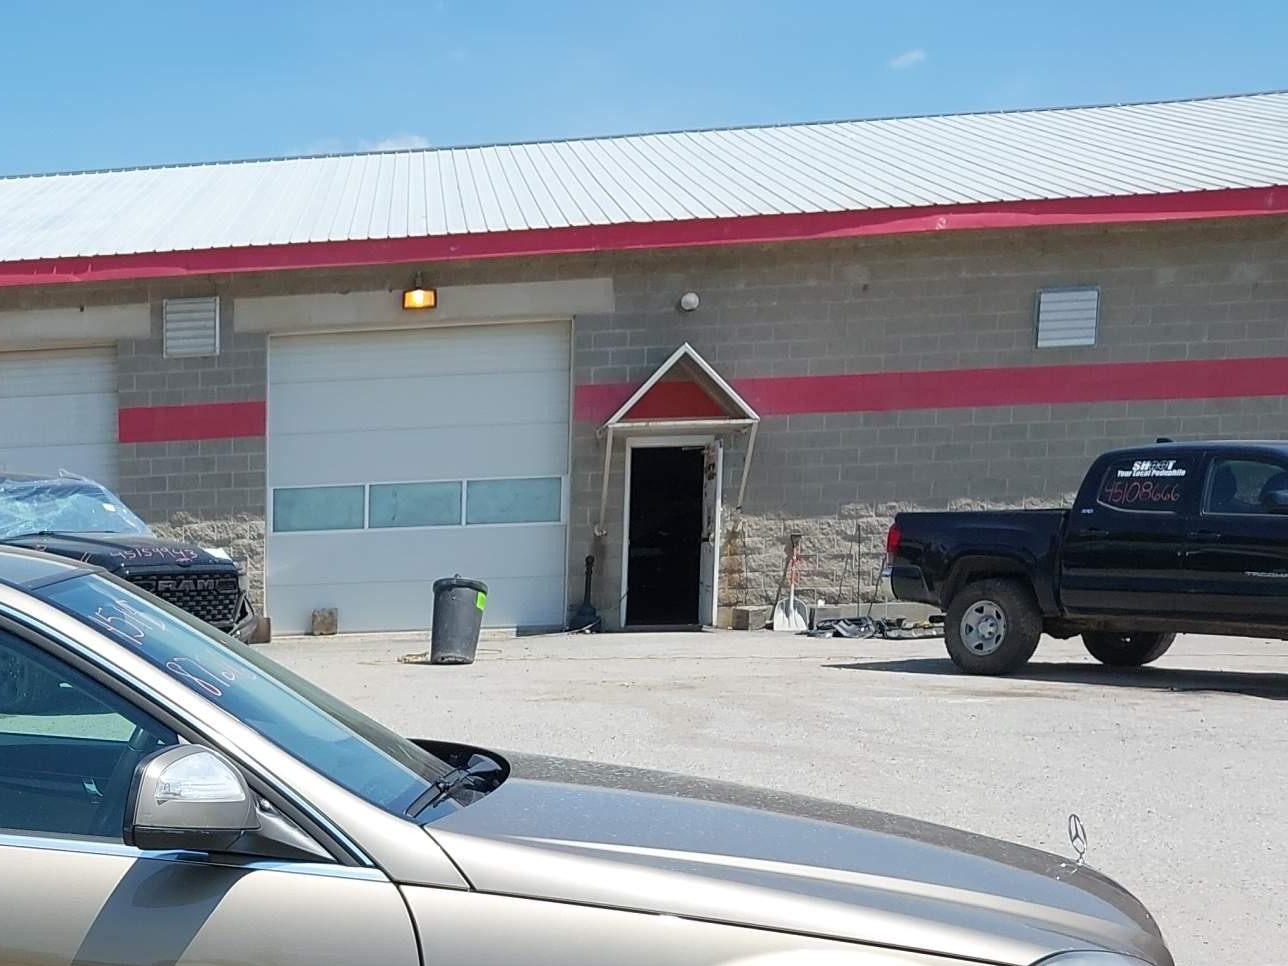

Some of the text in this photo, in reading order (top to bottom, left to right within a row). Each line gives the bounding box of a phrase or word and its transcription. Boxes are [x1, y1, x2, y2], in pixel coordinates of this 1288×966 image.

[1132, 460, 1177, 470] SHOOT
[1132, 469, 1151, 477] Local
[1104, 481, 1180, 504] 45108666
[158, 579, 215, 592] RAM
